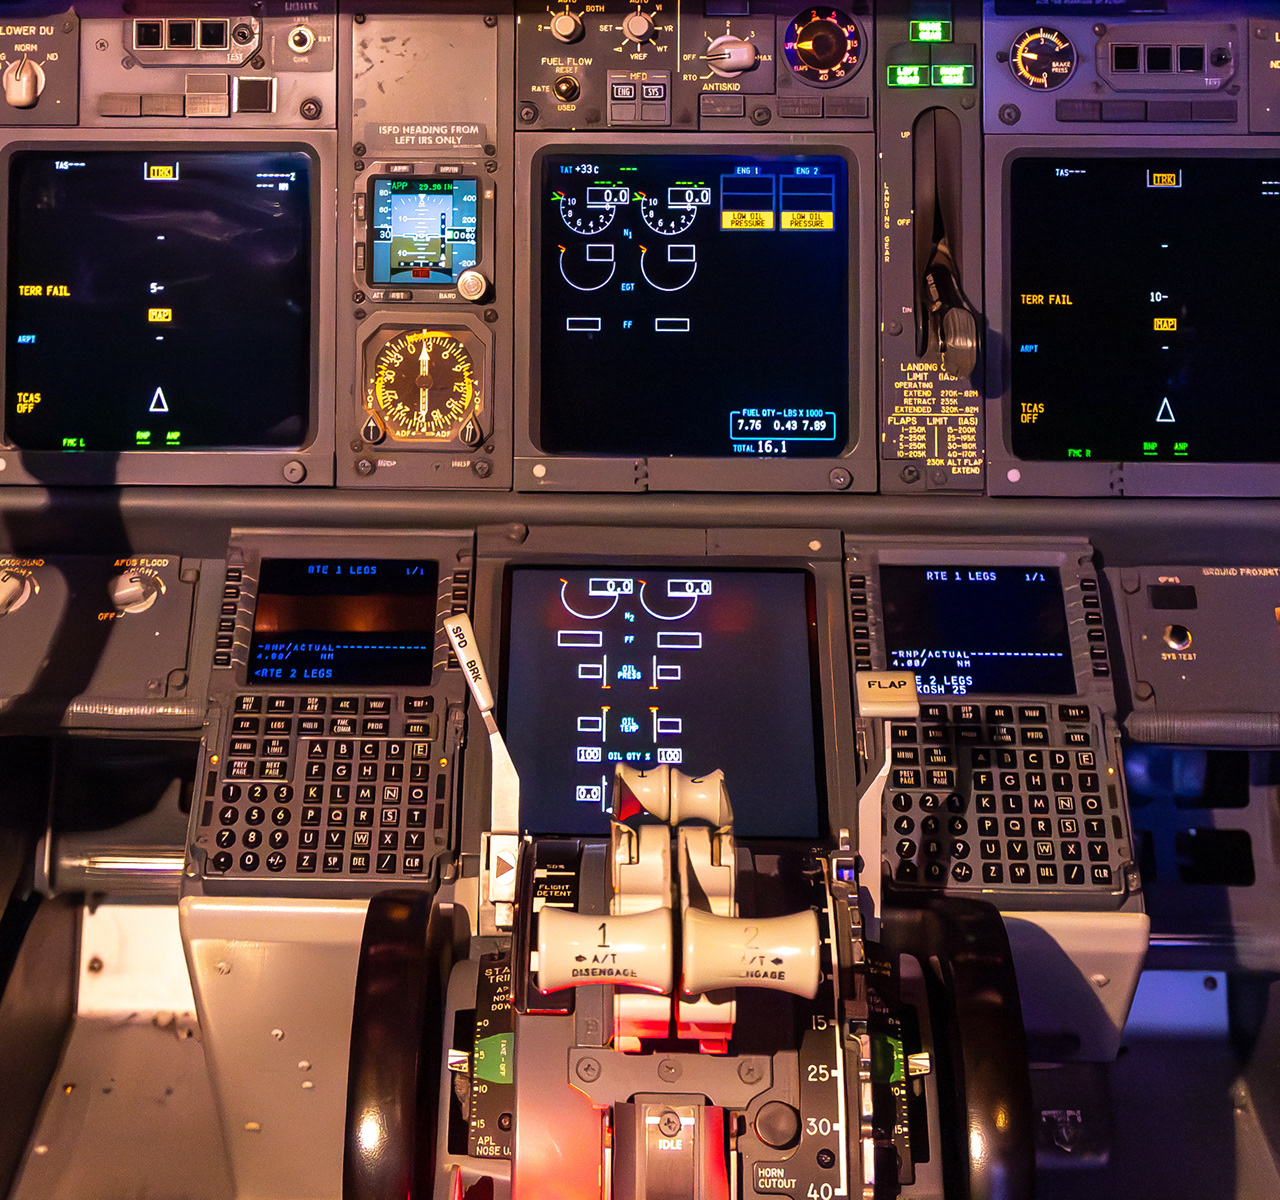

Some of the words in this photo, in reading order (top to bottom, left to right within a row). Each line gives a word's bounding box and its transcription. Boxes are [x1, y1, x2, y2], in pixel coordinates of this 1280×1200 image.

[0, 26, 31, 36] LOWER
[36, 26, 53, 35] DU
[541, 58, 563, 66] FUEL
[568, 58, 592, 66] FLOW
[703, 83, 741, 91] ANTISKID
[379, 126, 399, 134] ISFD
[403, 126, 447, 134] HEADING
[451, 126, 479, 134] FROM
[395, 136, 415, 144] LEFT
[419, 136, 432, 144] IRS
[436, 136, 462, 144] ONLY
[604, 190, 628, 202] 0.0
[19, 285, 42, 296] TERR
[47, 285, 70, 296] FAIL
[621, 283, 634, 291] EGT
[1021, 295, 1044, 305] TERR
[1049, 295, 1072, 305] FAIL
[17, 393, 41, 403] TCAS
[17, 404, 33, 413] OFF
[1021, 403, 1044, 413] TCAS
[888, 417, 917, 425] FLAPS
[927, 417, 948, 425] LIMIT
[958, 417, 978, 425] (IAS)
[1021, 414, 1038, 423] OFF
[738, 420, 761, 430] 7.76
[774, 420, 797, 430] 0.43
[802, 420, 826, 430] 7.89
[733, 444, 754, 452] TOTAL
[758, 441, 787, 453] 16.1
[114, 559, 137, 567] AFDS
[141, 559, 168, 567] FLOOD
[350, 566, 377, 574] LEGS
[927, 572, 947, 580] RTE
[955, 572, 962, 580] 1
[968, 572, 997, 581] LEGS
[452, 626, 467, 649] SPD
[466, 660, 482, 683] BRK
[868, 681, 907, 689] FLAP
[579, 750, 598, 759] 100
[406, 858, 419, 866] CLR
[597, 923, 608, 948] 1
[592, 954, 617, 964] A/T
[572, 969, 637, 978] DISENGAGE
[807, 1065, 830, 1081] 25
[806, 1119, 831, 1134] 30
[659, 1139, 682, 1150] IDLE
[758, 1169, 784, 1178] HORN
[758, 1179, 796, 1188] CUTOUT
[807, 1184, 832, 1200] 40
